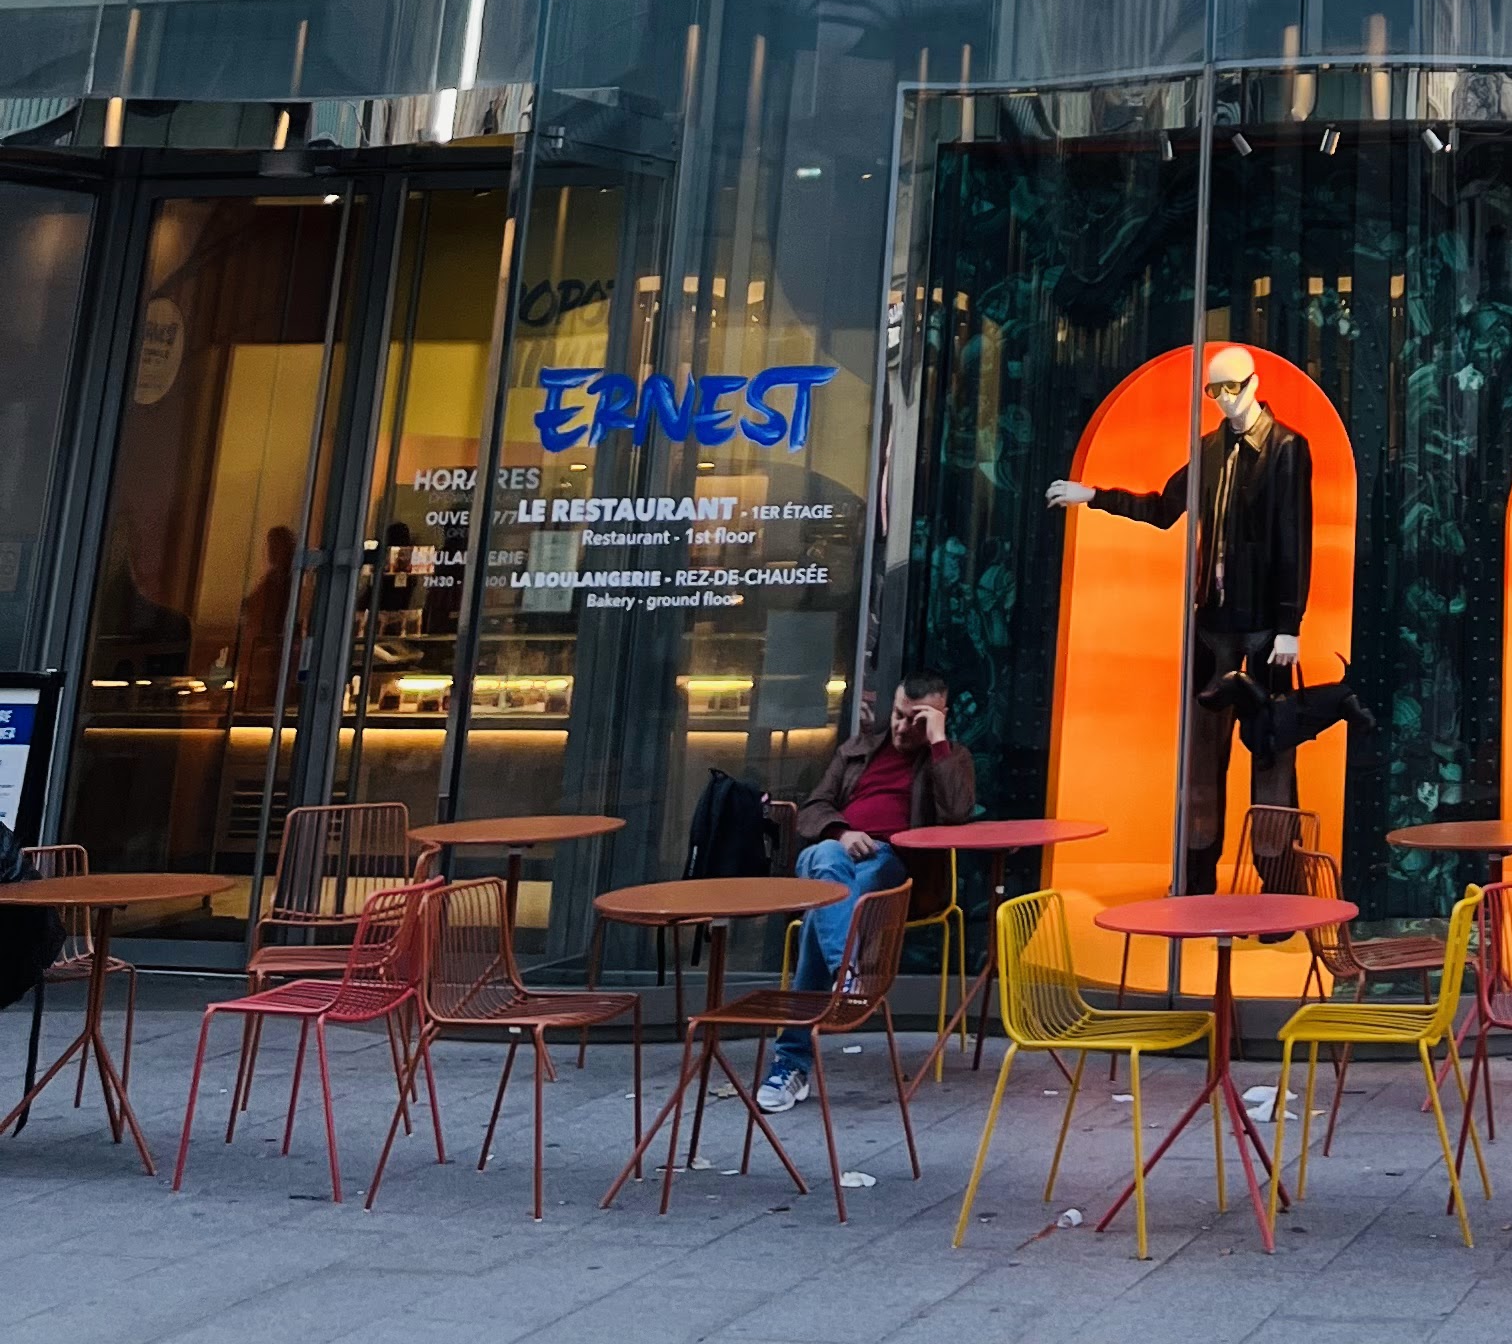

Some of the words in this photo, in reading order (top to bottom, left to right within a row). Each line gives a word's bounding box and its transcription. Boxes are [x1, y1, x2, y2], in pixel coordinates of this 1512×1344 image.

[534, 364, 839, 452] ERNEST
[518, 499, 546, 523] LE
[552, 497, 738, 523] RESTAURANT
[752, 506, 781, 519] 1ER
[784, 502, 834, 520] ÉTAGE
[582, 529, 670, 546] Restaurant
[686, 528, 710, 545] 1st
[714, 527, 757, 544] floor
[511, 572, 532, 588] LA
[535, 570, 661, 589] BOULANGERIE
[675, 564, 829, 587] REZ-DE-CHAUSÉE
[587, 593, 635, 611] Bakery
[647, 592, 699, 611] ground
